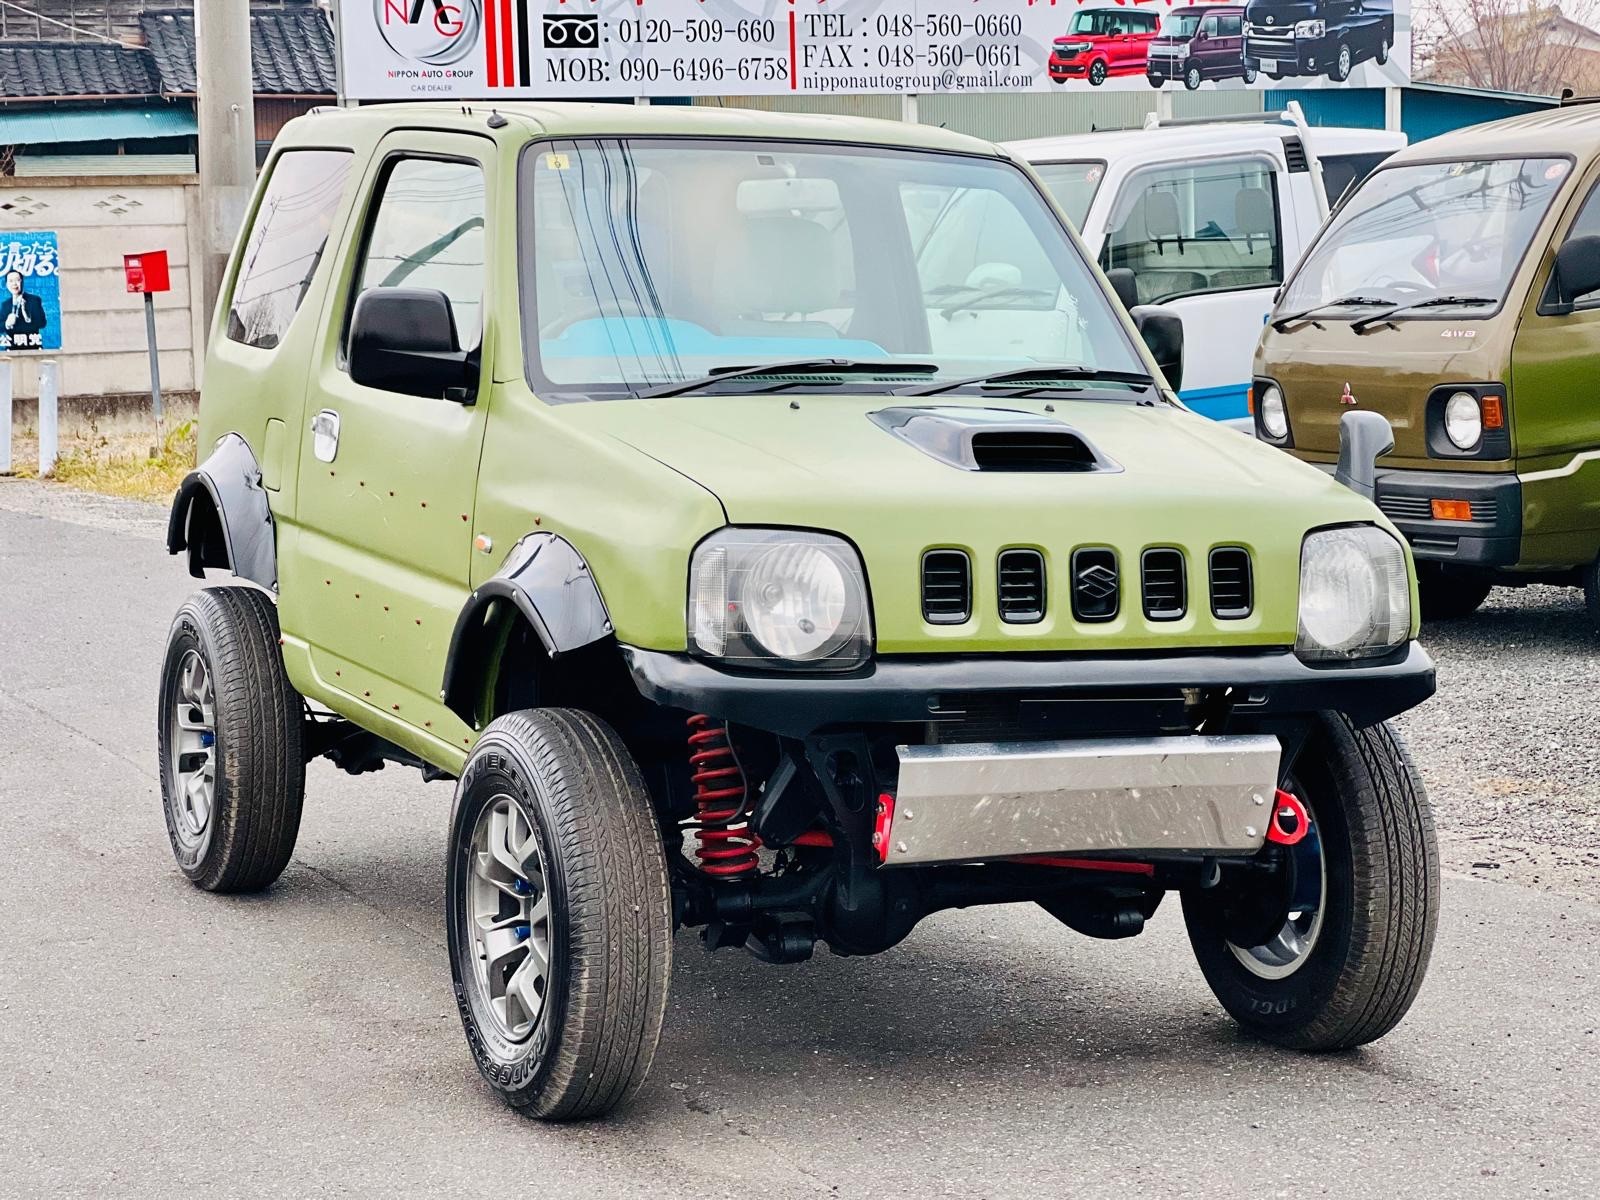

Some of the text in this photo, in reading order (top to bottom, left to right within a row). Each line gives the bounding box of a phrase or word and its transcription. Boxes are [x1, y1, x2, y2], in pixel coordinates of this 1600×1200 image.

[618, 18, 775, 43] 0120-509-660
[876, 14, 1022, 37] 048-560-0660
[877, 43, 1022, 68] 048-560-0661
[387, 70, 474, 78] NIPPON AUTO GROUP
[619, 57, 789, 82] 090-6496-6758
[803, 69, 1033, 92] nipponautogroup@gmail.com
[411, 84, 452, 92] CAR DEALER
[0, 333, 42, 347] 公明党
[1440, 329, 1476, 338] 4WD
